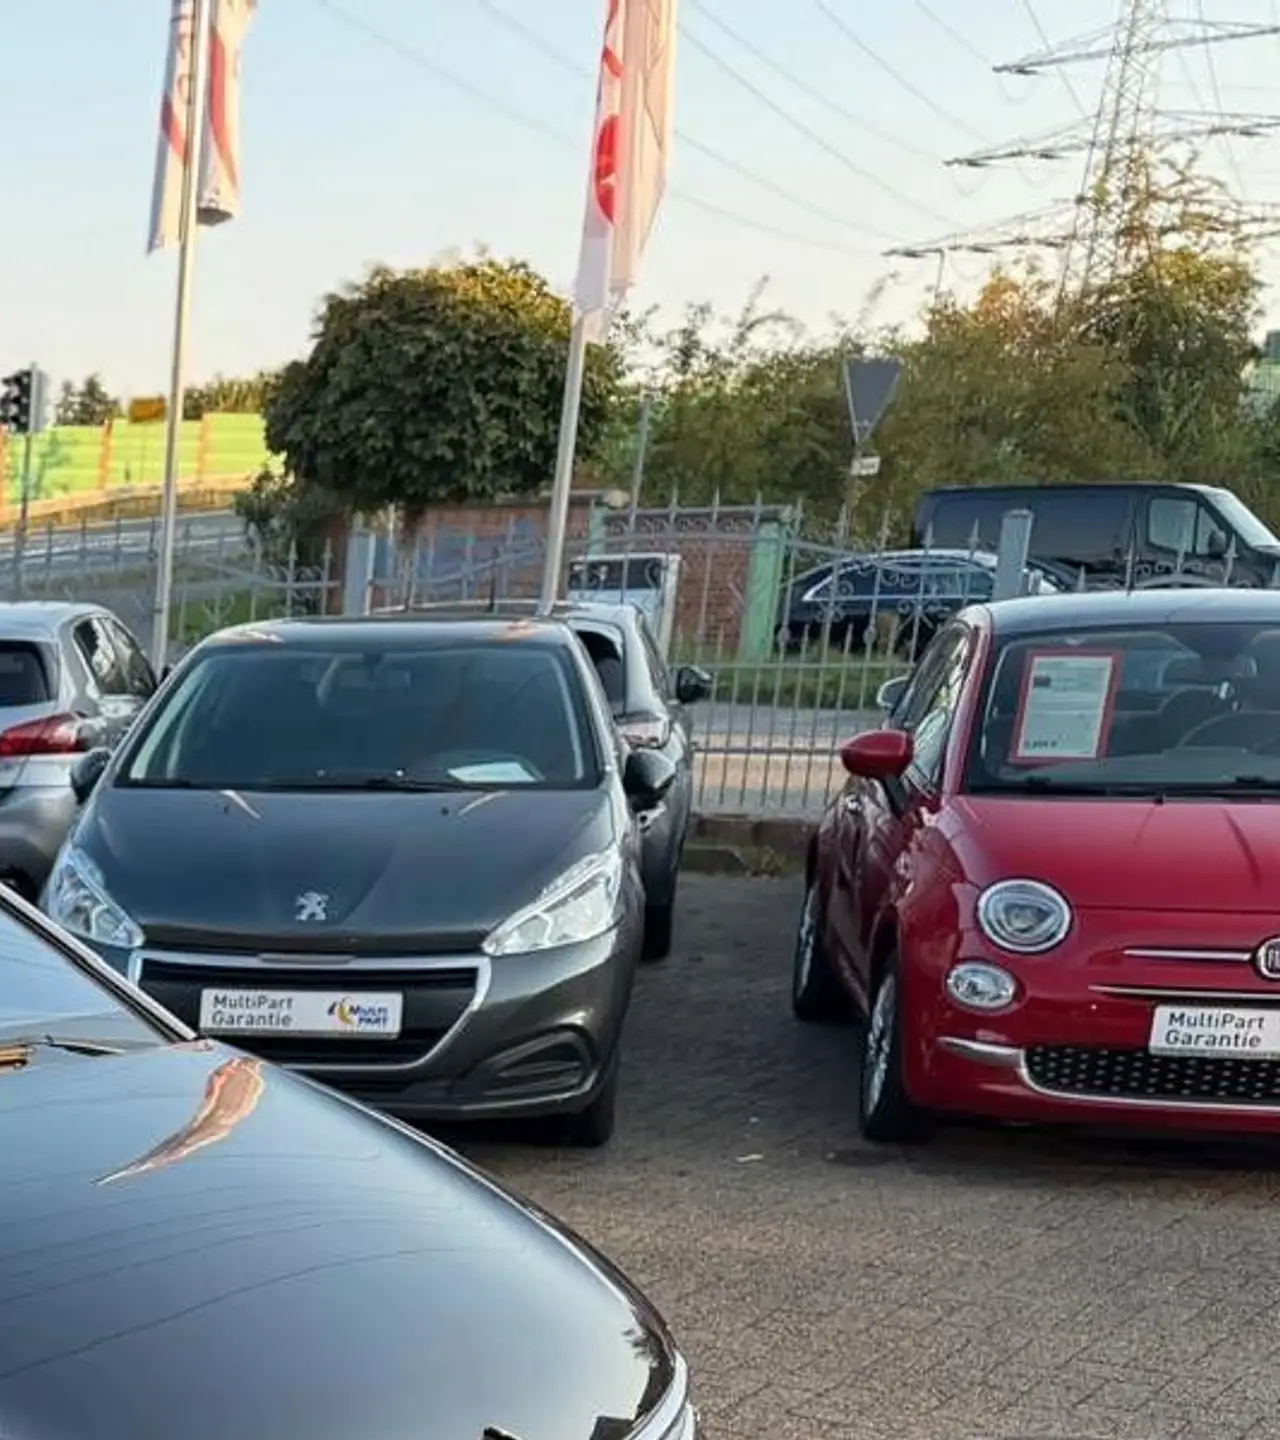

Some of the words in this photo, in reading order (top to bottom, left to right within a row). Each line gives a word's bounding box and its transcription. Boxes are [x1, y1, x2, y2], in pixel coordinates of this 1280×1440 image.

[212, 994, 293, 1010] MultiPart
[211, 1010, 293, 1027] Garantie
[1167, 1011, 1265, 1029] MultiPart
[1164, 1029, 1263, 1048] Garantie
